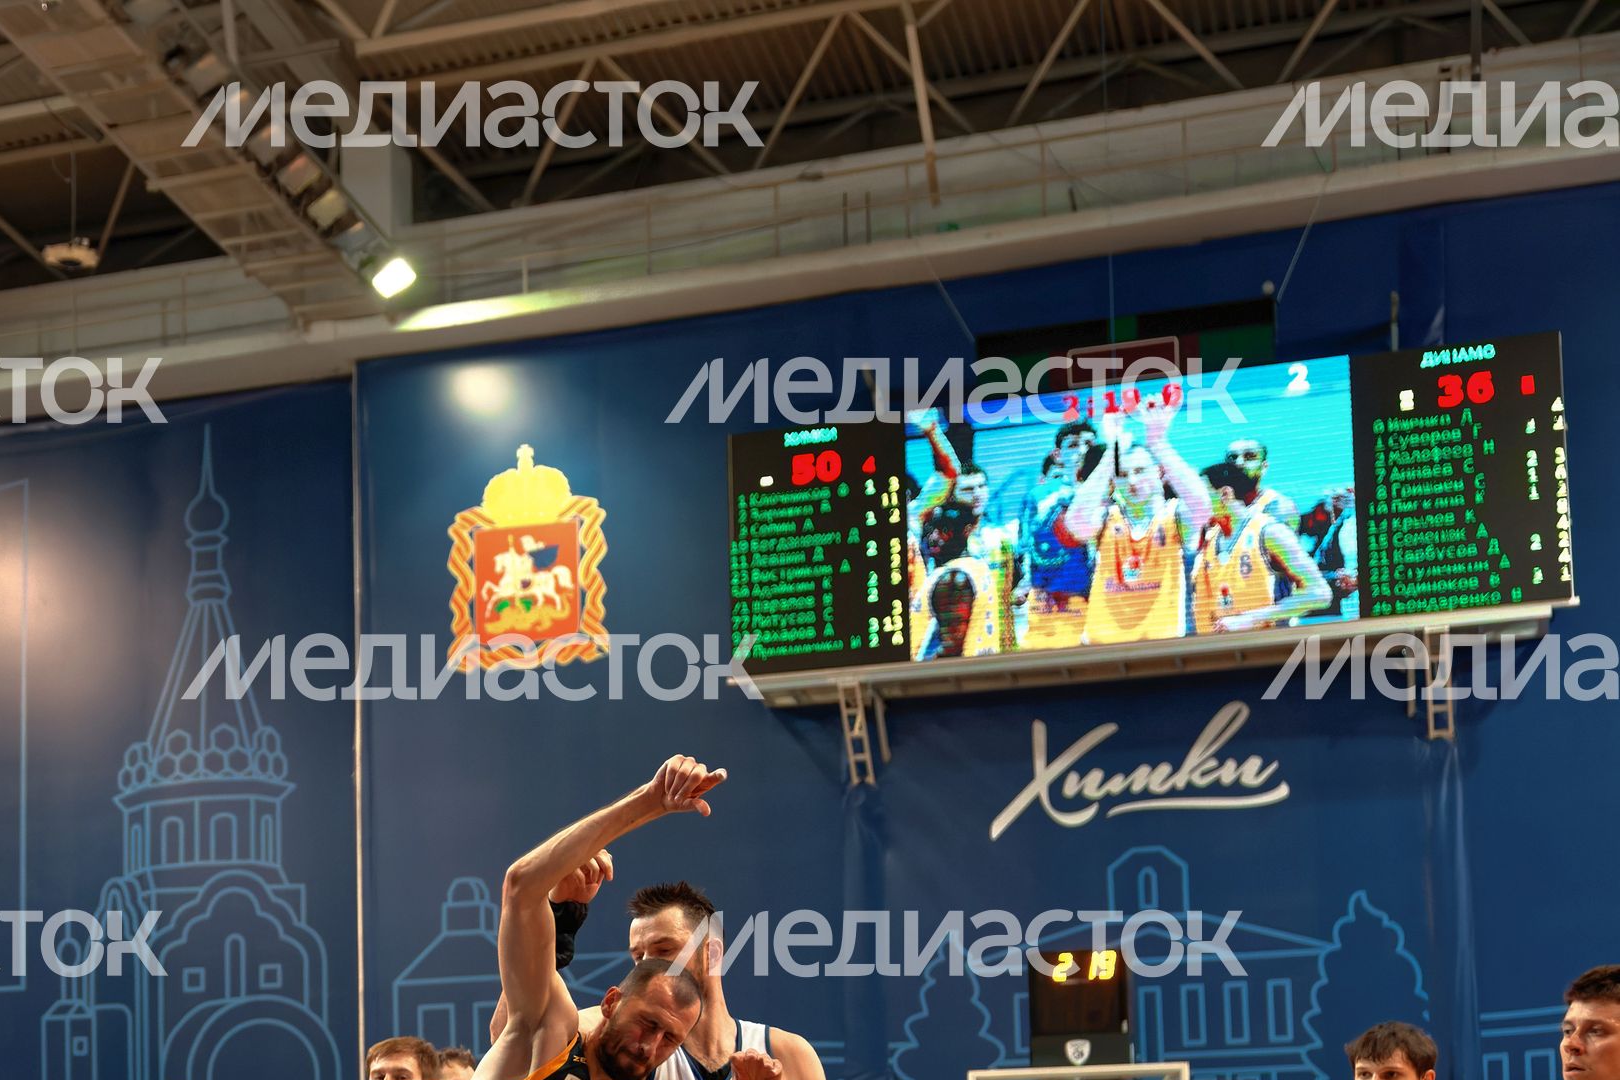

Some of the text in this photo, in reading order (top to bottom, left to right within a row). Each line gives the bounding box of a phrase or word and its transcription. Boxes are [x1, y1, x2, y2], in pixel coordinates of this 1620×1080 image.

[1288, 363, 1310, 391] 2
[1438, 371, 1495, 408] 36
[1388, 428, 1462, 450] Суворов
[1389, 443, 1474, 466] Малофеев
[1483, 438, 1495, 455] Н
[791, 450, 842, 485] 50
[1463, 457, 1475, 474] С
[1530, 534, 1542, 550] 2
[823, 606, 834, 621] С
